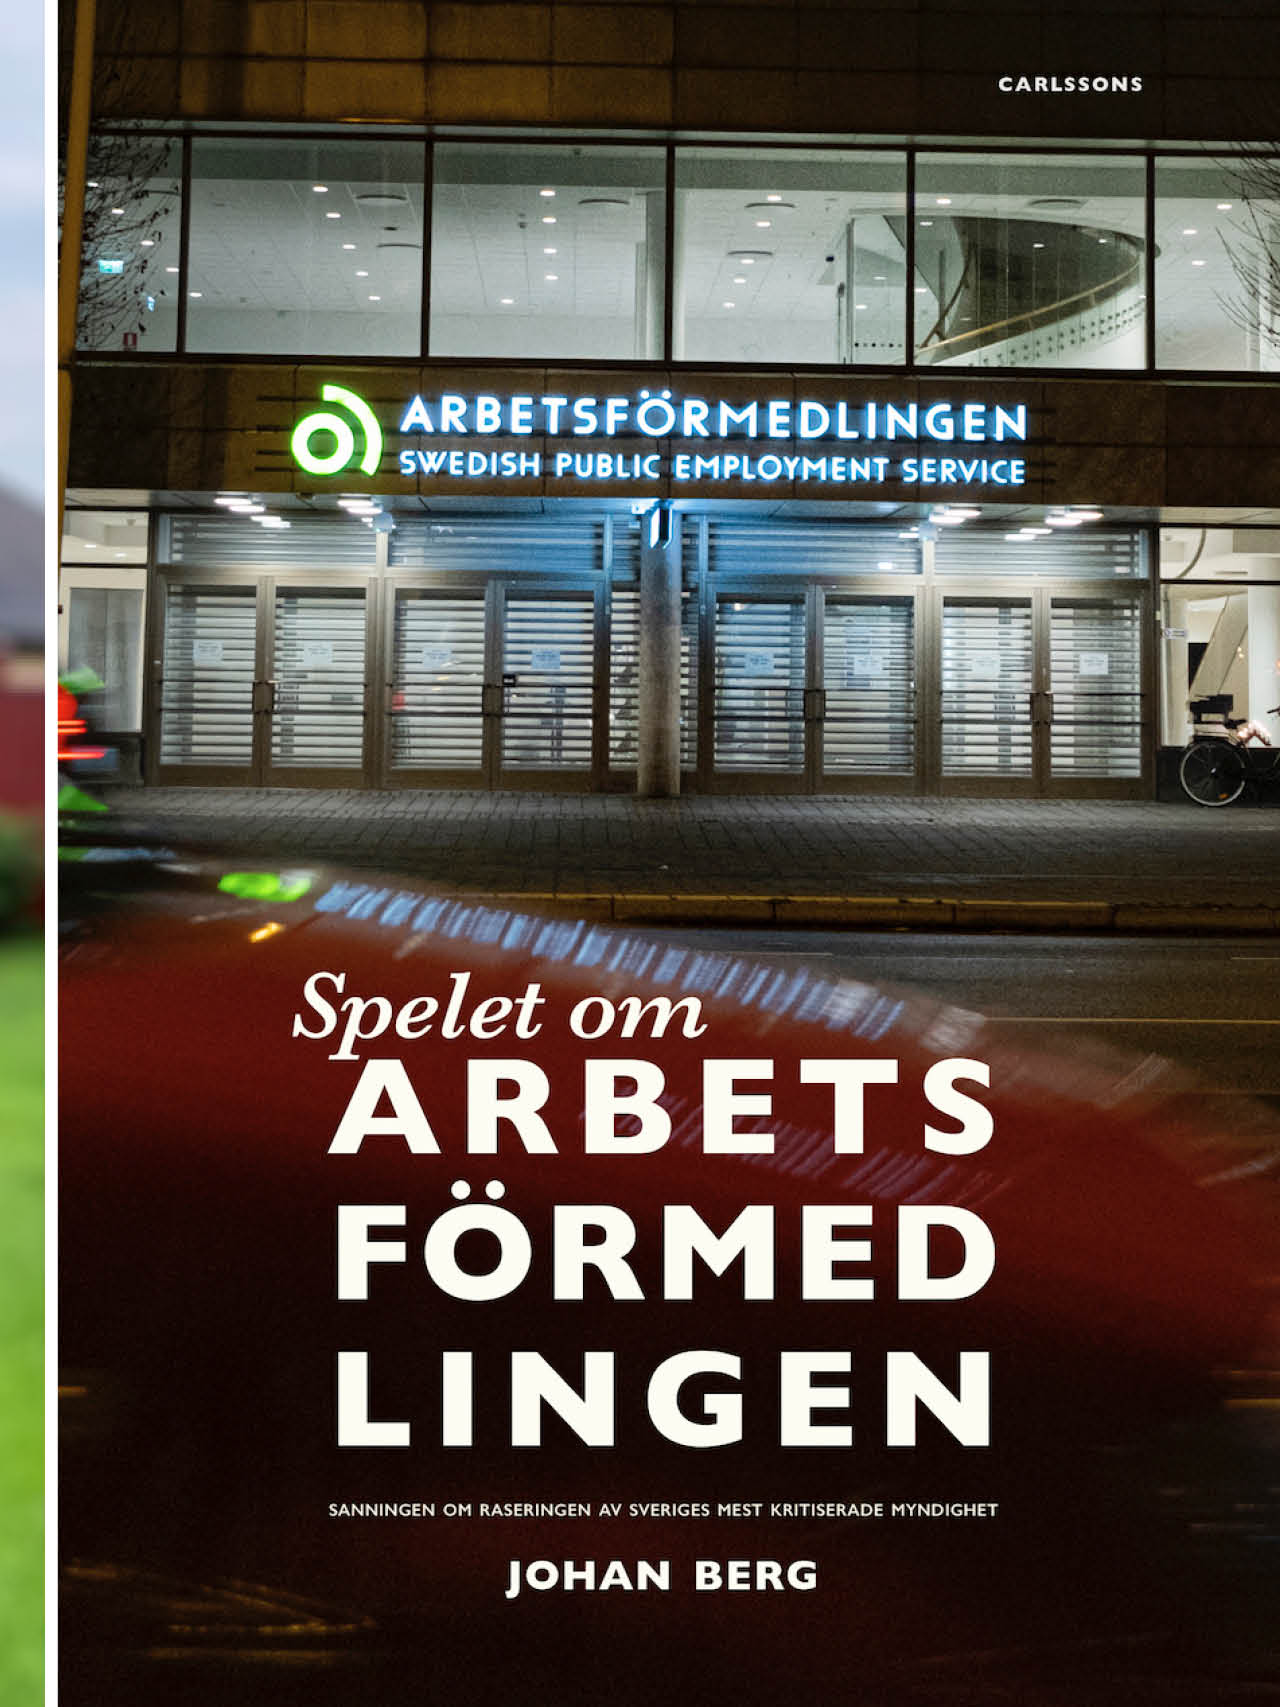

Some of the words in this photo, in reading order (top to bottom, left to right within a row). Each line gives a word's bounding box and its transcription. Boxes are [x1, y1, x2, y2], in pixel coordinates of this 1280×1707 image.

[400, 389, 1027, 441] ARBETSFÖRMEDLINGEN
[399, 450, 540, 477] SWEDISH
[556, 453, 661, 480] PUBLIC
[675, 455, 889, 483] EMPLOYMENT
[902, 457, 1026, 485] SERVICE
